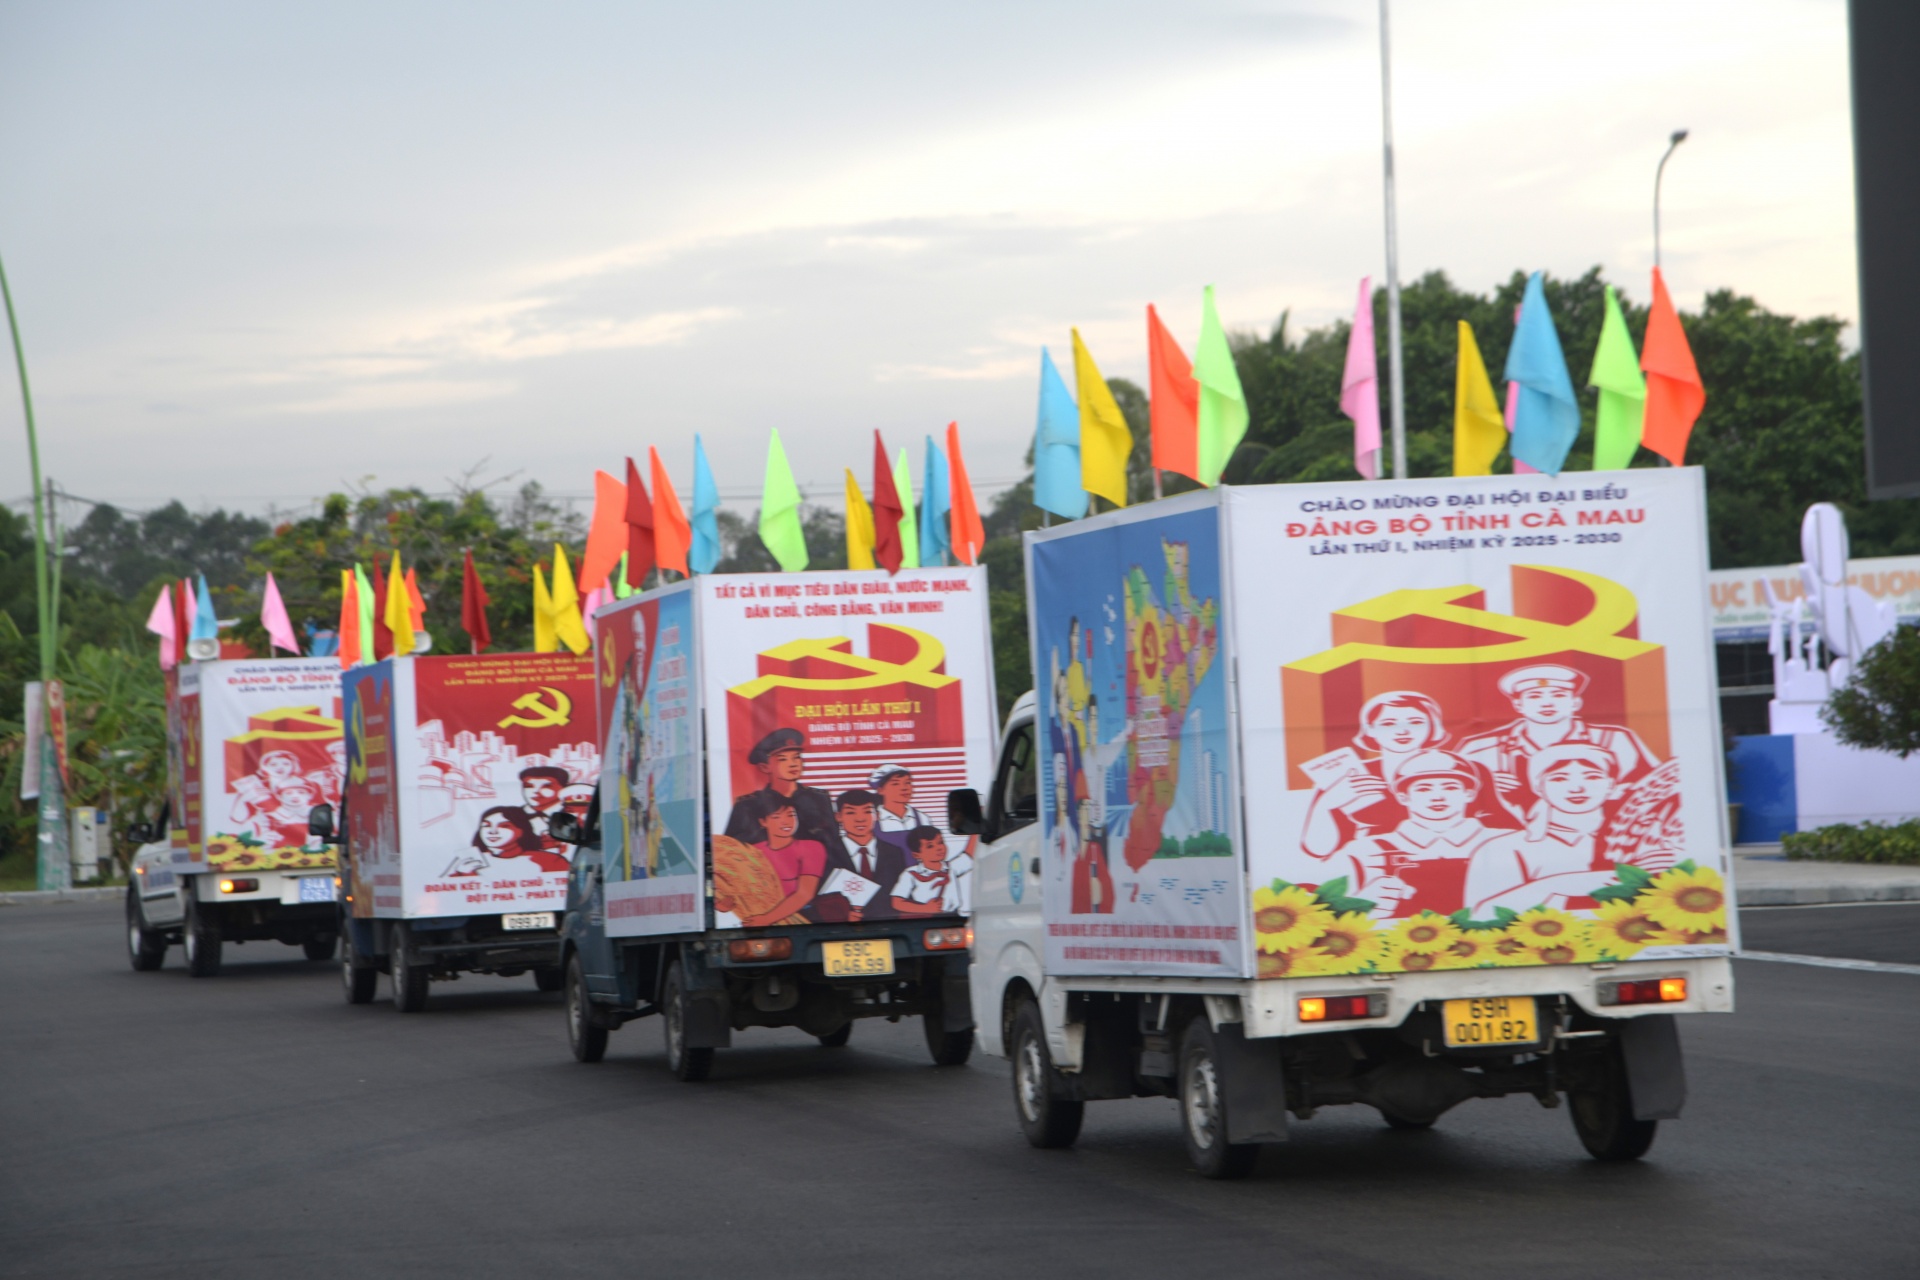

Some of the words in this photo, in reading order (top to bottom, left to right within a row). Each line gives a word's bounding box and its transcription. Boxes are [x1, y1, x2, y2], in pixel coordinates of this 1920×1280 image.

[1300, 497, 1366, 512] CHÀO
[1373, 495, 1439, 509] MỪNG
[1447, 494, 1485, 509] ĐẠI
[1491, 490, 1531, 507] HỘI
[1537, 490, 1576, 505] ĐẠI
[1582, 483, 1628, 501] BIỂU
[1285, 516, 1378, 538] ĐẢNG
[1388, 513, 1431, 537] BỘ
[1440, 511, 1510, 531] TỈNH
[1520, 508, 1566, 528] CÀ
[1577, 508, 1645, 525] MAU
[1310, 540, 1348, 555] LẦN
[1353, 539, 1391, 553] THỨ
[1413, 536, 1475, 552] NHIỆM
[1482, 535, 1507, 548] KỲ
[1512, 535, 1558, 547] 2025
[1575, 532, 1621, 544] 2030
[844, 942, 871, 957] 69C
[832, 958, 885, 973] 046.99
[1470, 999, 1510, 1018] 69H
[1456, 1020, 1527, 1042] 001.82
